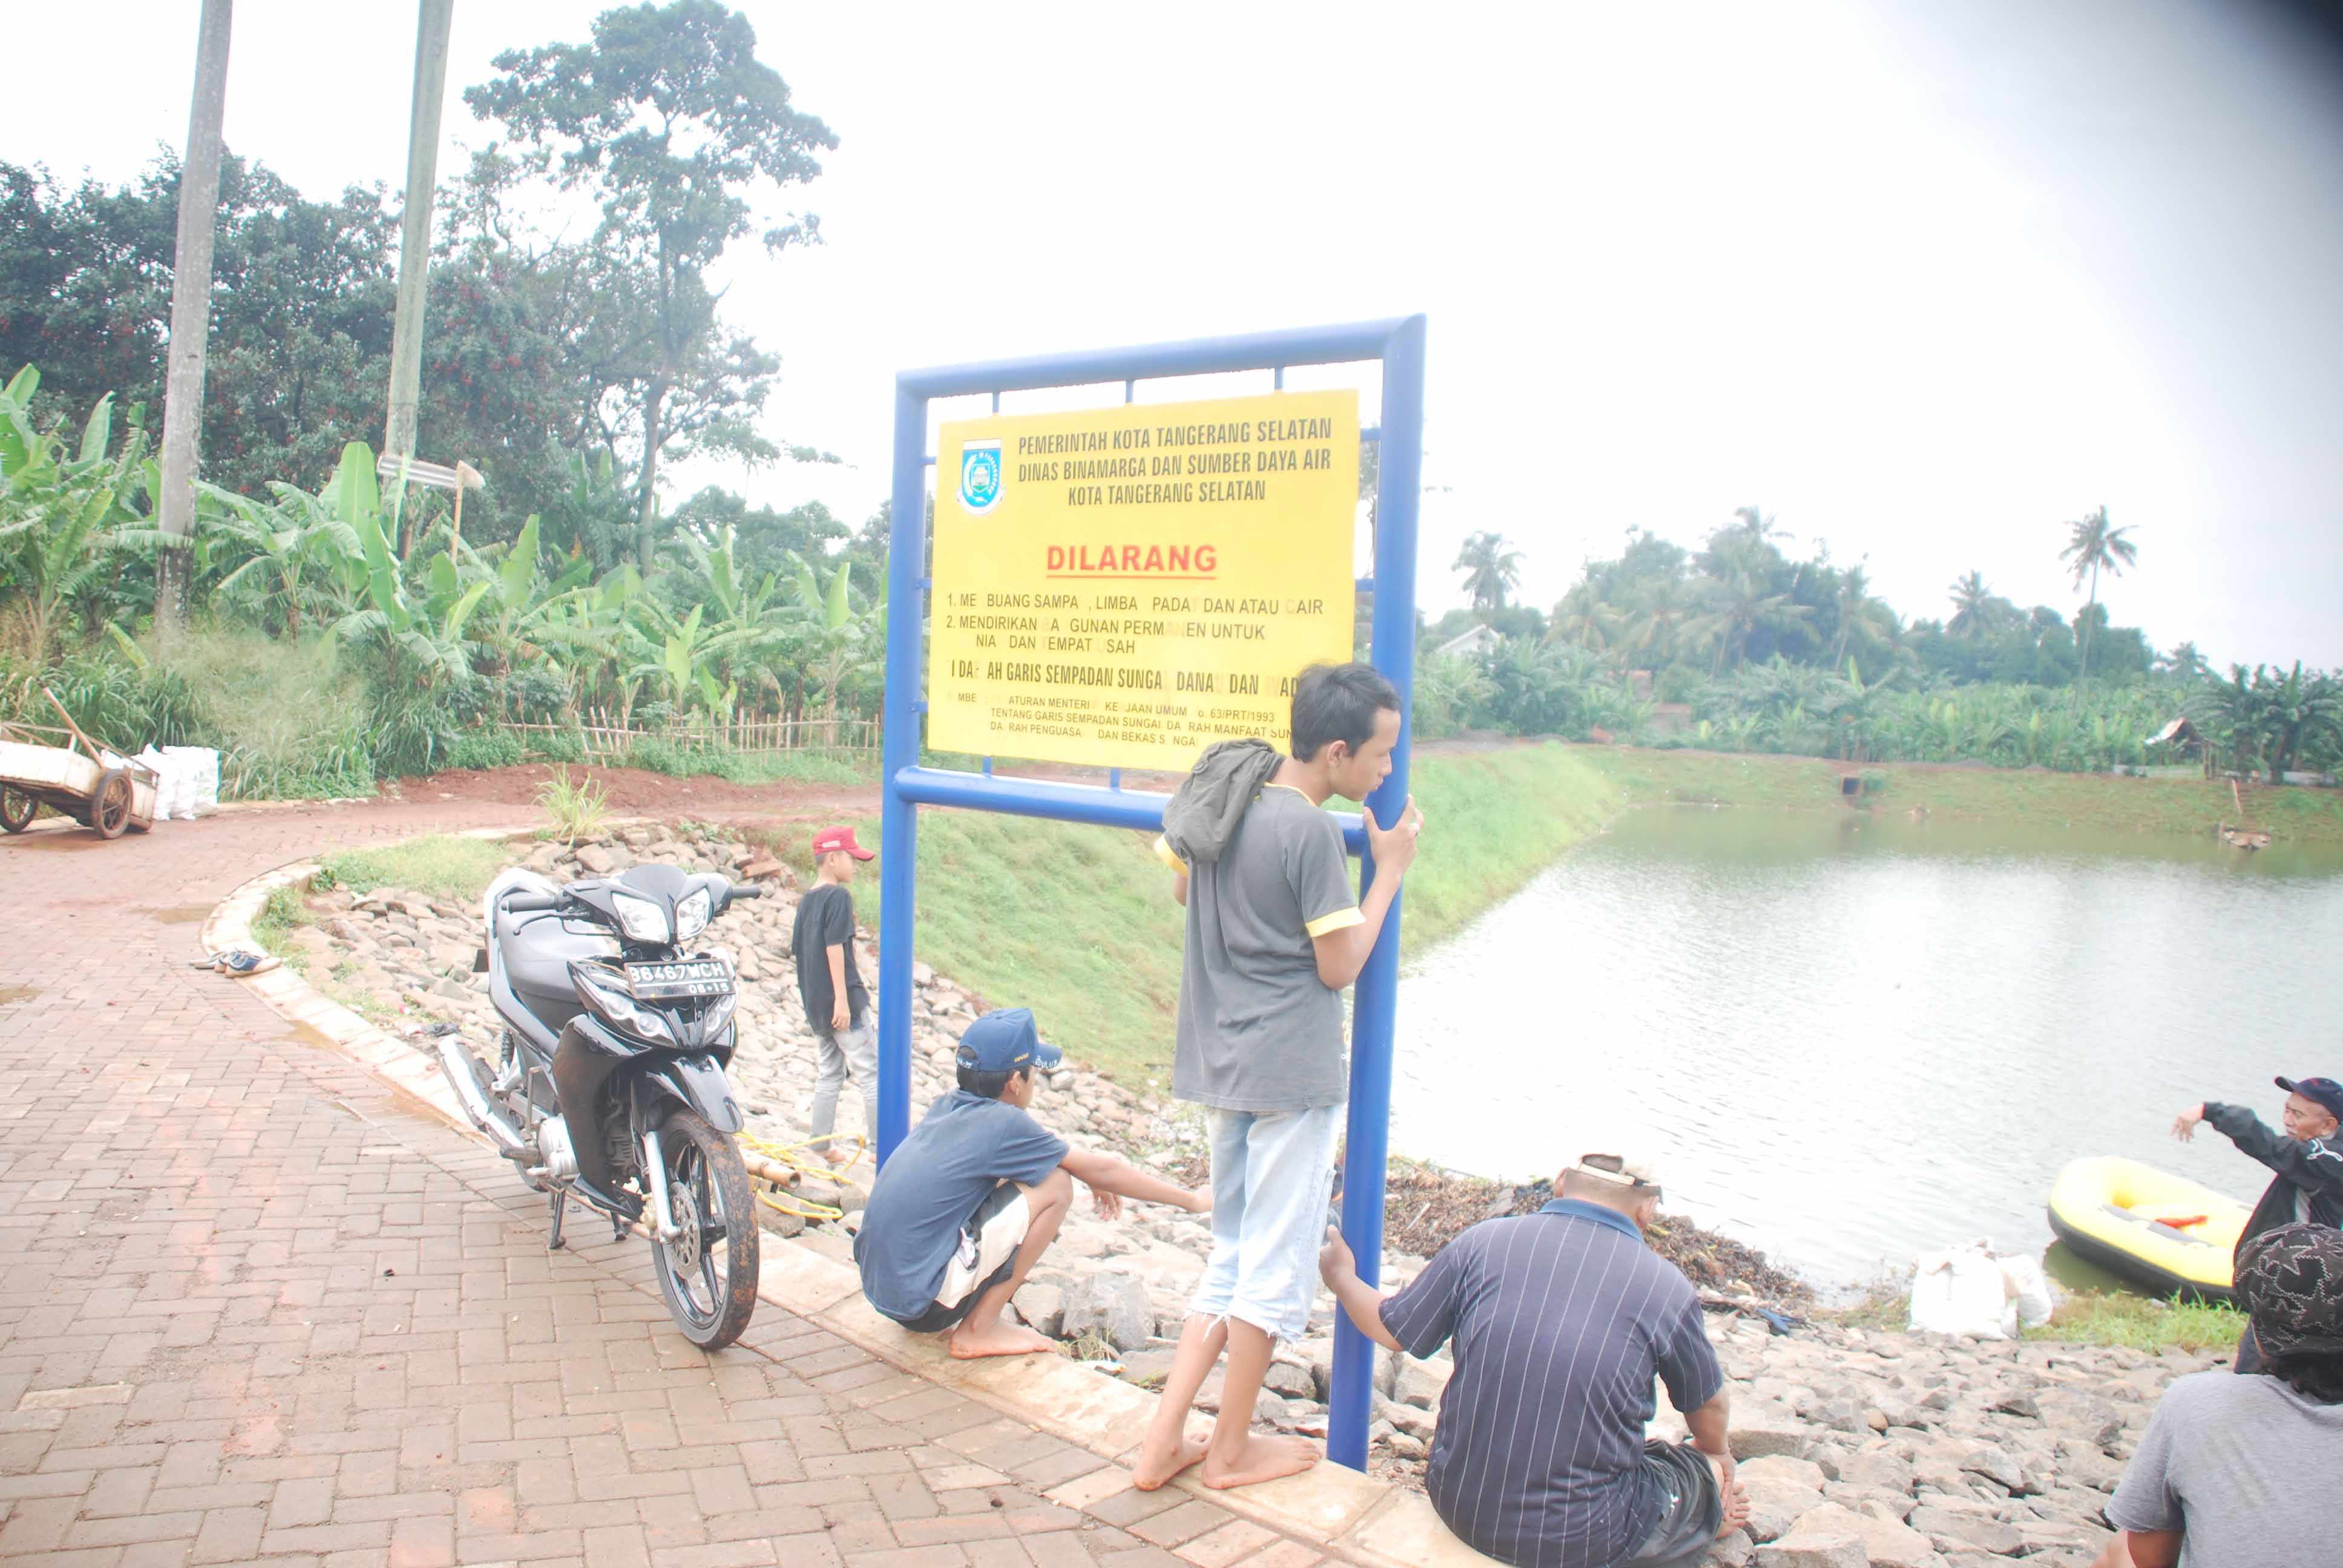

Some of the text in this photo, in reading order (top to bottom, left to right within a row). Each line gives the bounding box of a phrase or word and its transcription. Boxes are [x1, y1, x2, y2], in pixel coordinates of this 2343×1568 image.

[1018, 417, 1331, 455] PEMERINTAH KOTA TANGERANG SELATAN
[1018, 448, 1331, 483] DINAS BINAMARGA DAN SUMBER DAYA AIR
[1068, 480, 1265, 507] KOTA TANGERANG SELATAN
[1047, 544, 1217, 573] DILARANG
[947, 593, 957, 607] 1.
[960, 593, 1030, 609] MEBUANG
[1096, 595, 1139, 610] LIMBA
[1204, 597, 1235, 613] DAN
[1239, 598, 1279, 615] ATAU
[946, 615, 956, 629] 2.
[960, 615, 1037, 630] MENDIRIKAN
[1211, 624, 1265, 640] UNTUK
[1009, 635, 1036, 649] DAN
[1006, 662, 1041, 682] GARIS
[1046, 664, 1113, 687] SEMPADAN
[1118, 667, 1164, 690] SUNGA
[1229, 673, 1259, 695] DAN
[991, 708, 1032, 719] TENTANG
[1035, 711, 1063, 722] GARIS
[1066, 713, 1119, 726] SEMPADAN
[1214, 724, 1266, 737] MANFAAT
[1048, 697, 1090, 710] MENTERI
[1156, 705, 1188, 716] UMUM
[1210, 709, 1275, 722] 63/PRT/1993
[1031, 724, 1082, 737] PENGUASA
[1098, 729, 1118, 740] DAN
[1121, 730, 1156, 743] BEKAS
